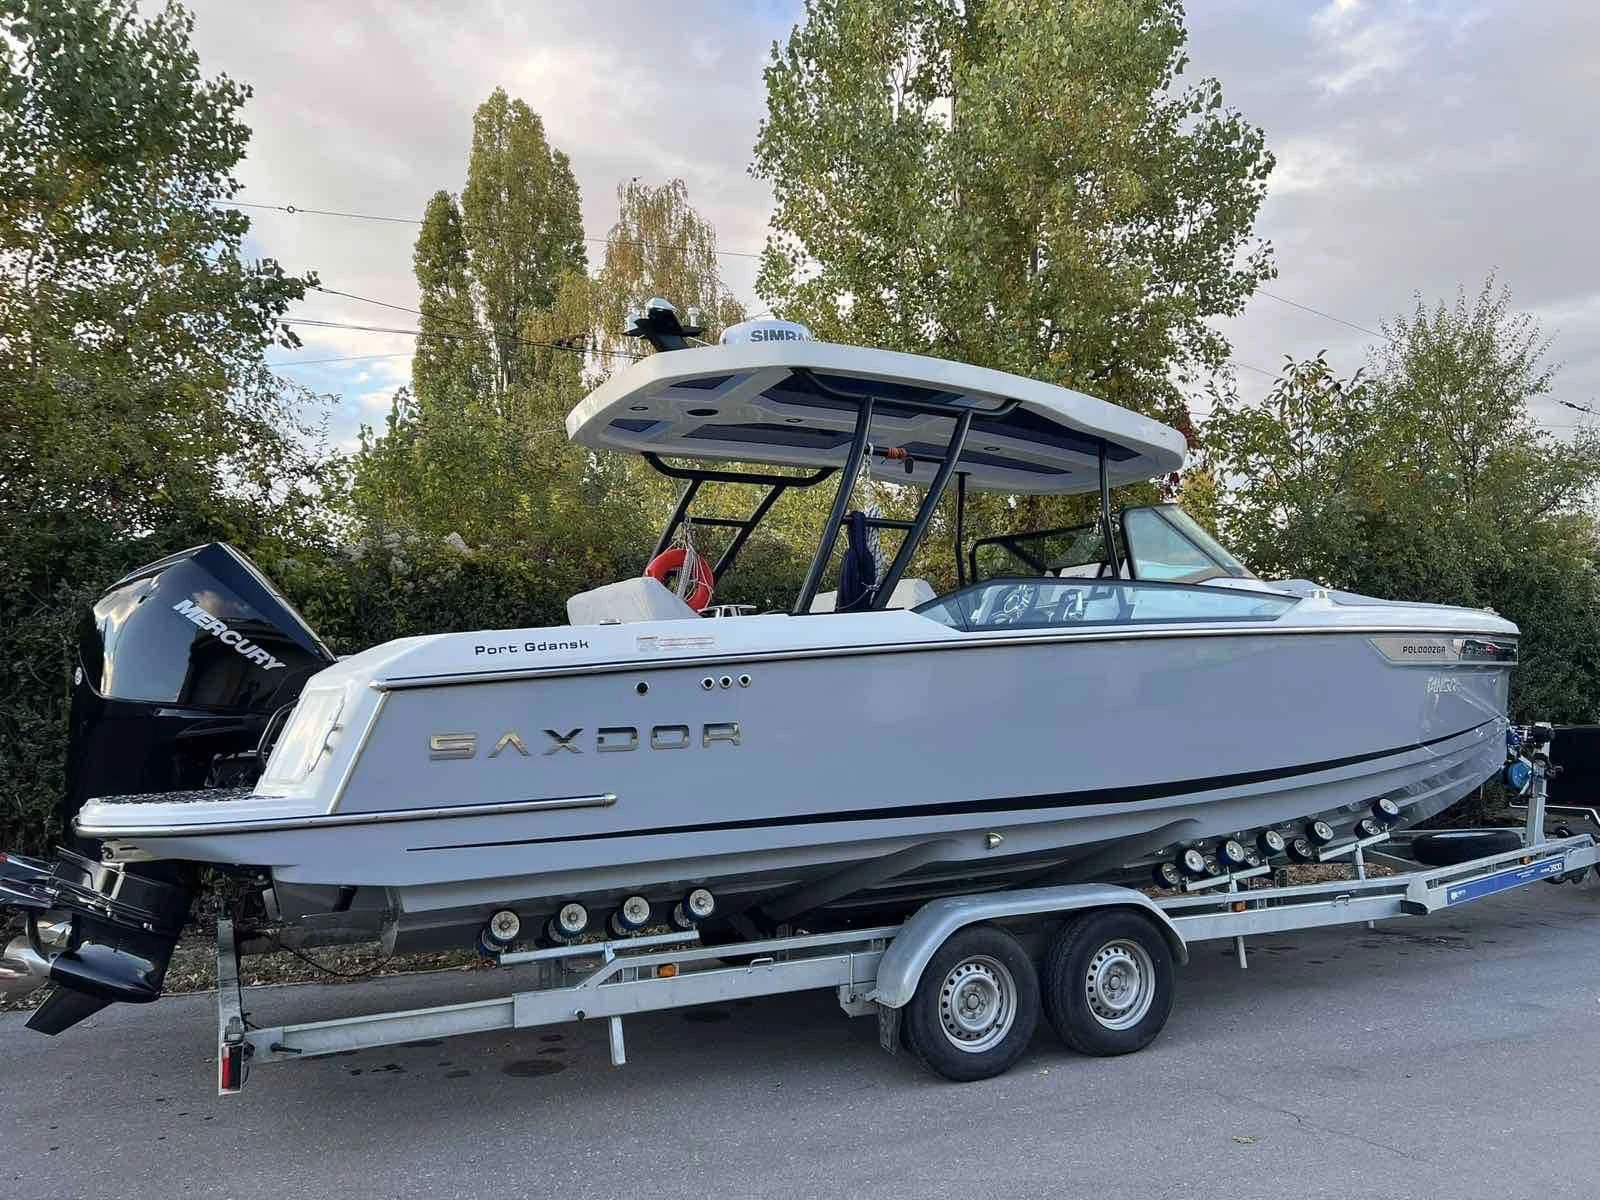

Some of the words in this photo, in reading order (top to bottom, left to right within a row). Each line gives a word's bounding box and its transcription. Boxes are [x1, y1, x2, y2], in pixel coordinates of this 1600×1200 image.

[172, 599, 286, 670] MERCURY
[474, 645, 518, 656] Port
[524, 639, 589, 652] Gdansk
[430, 722, 742, 760] SAXDOR
